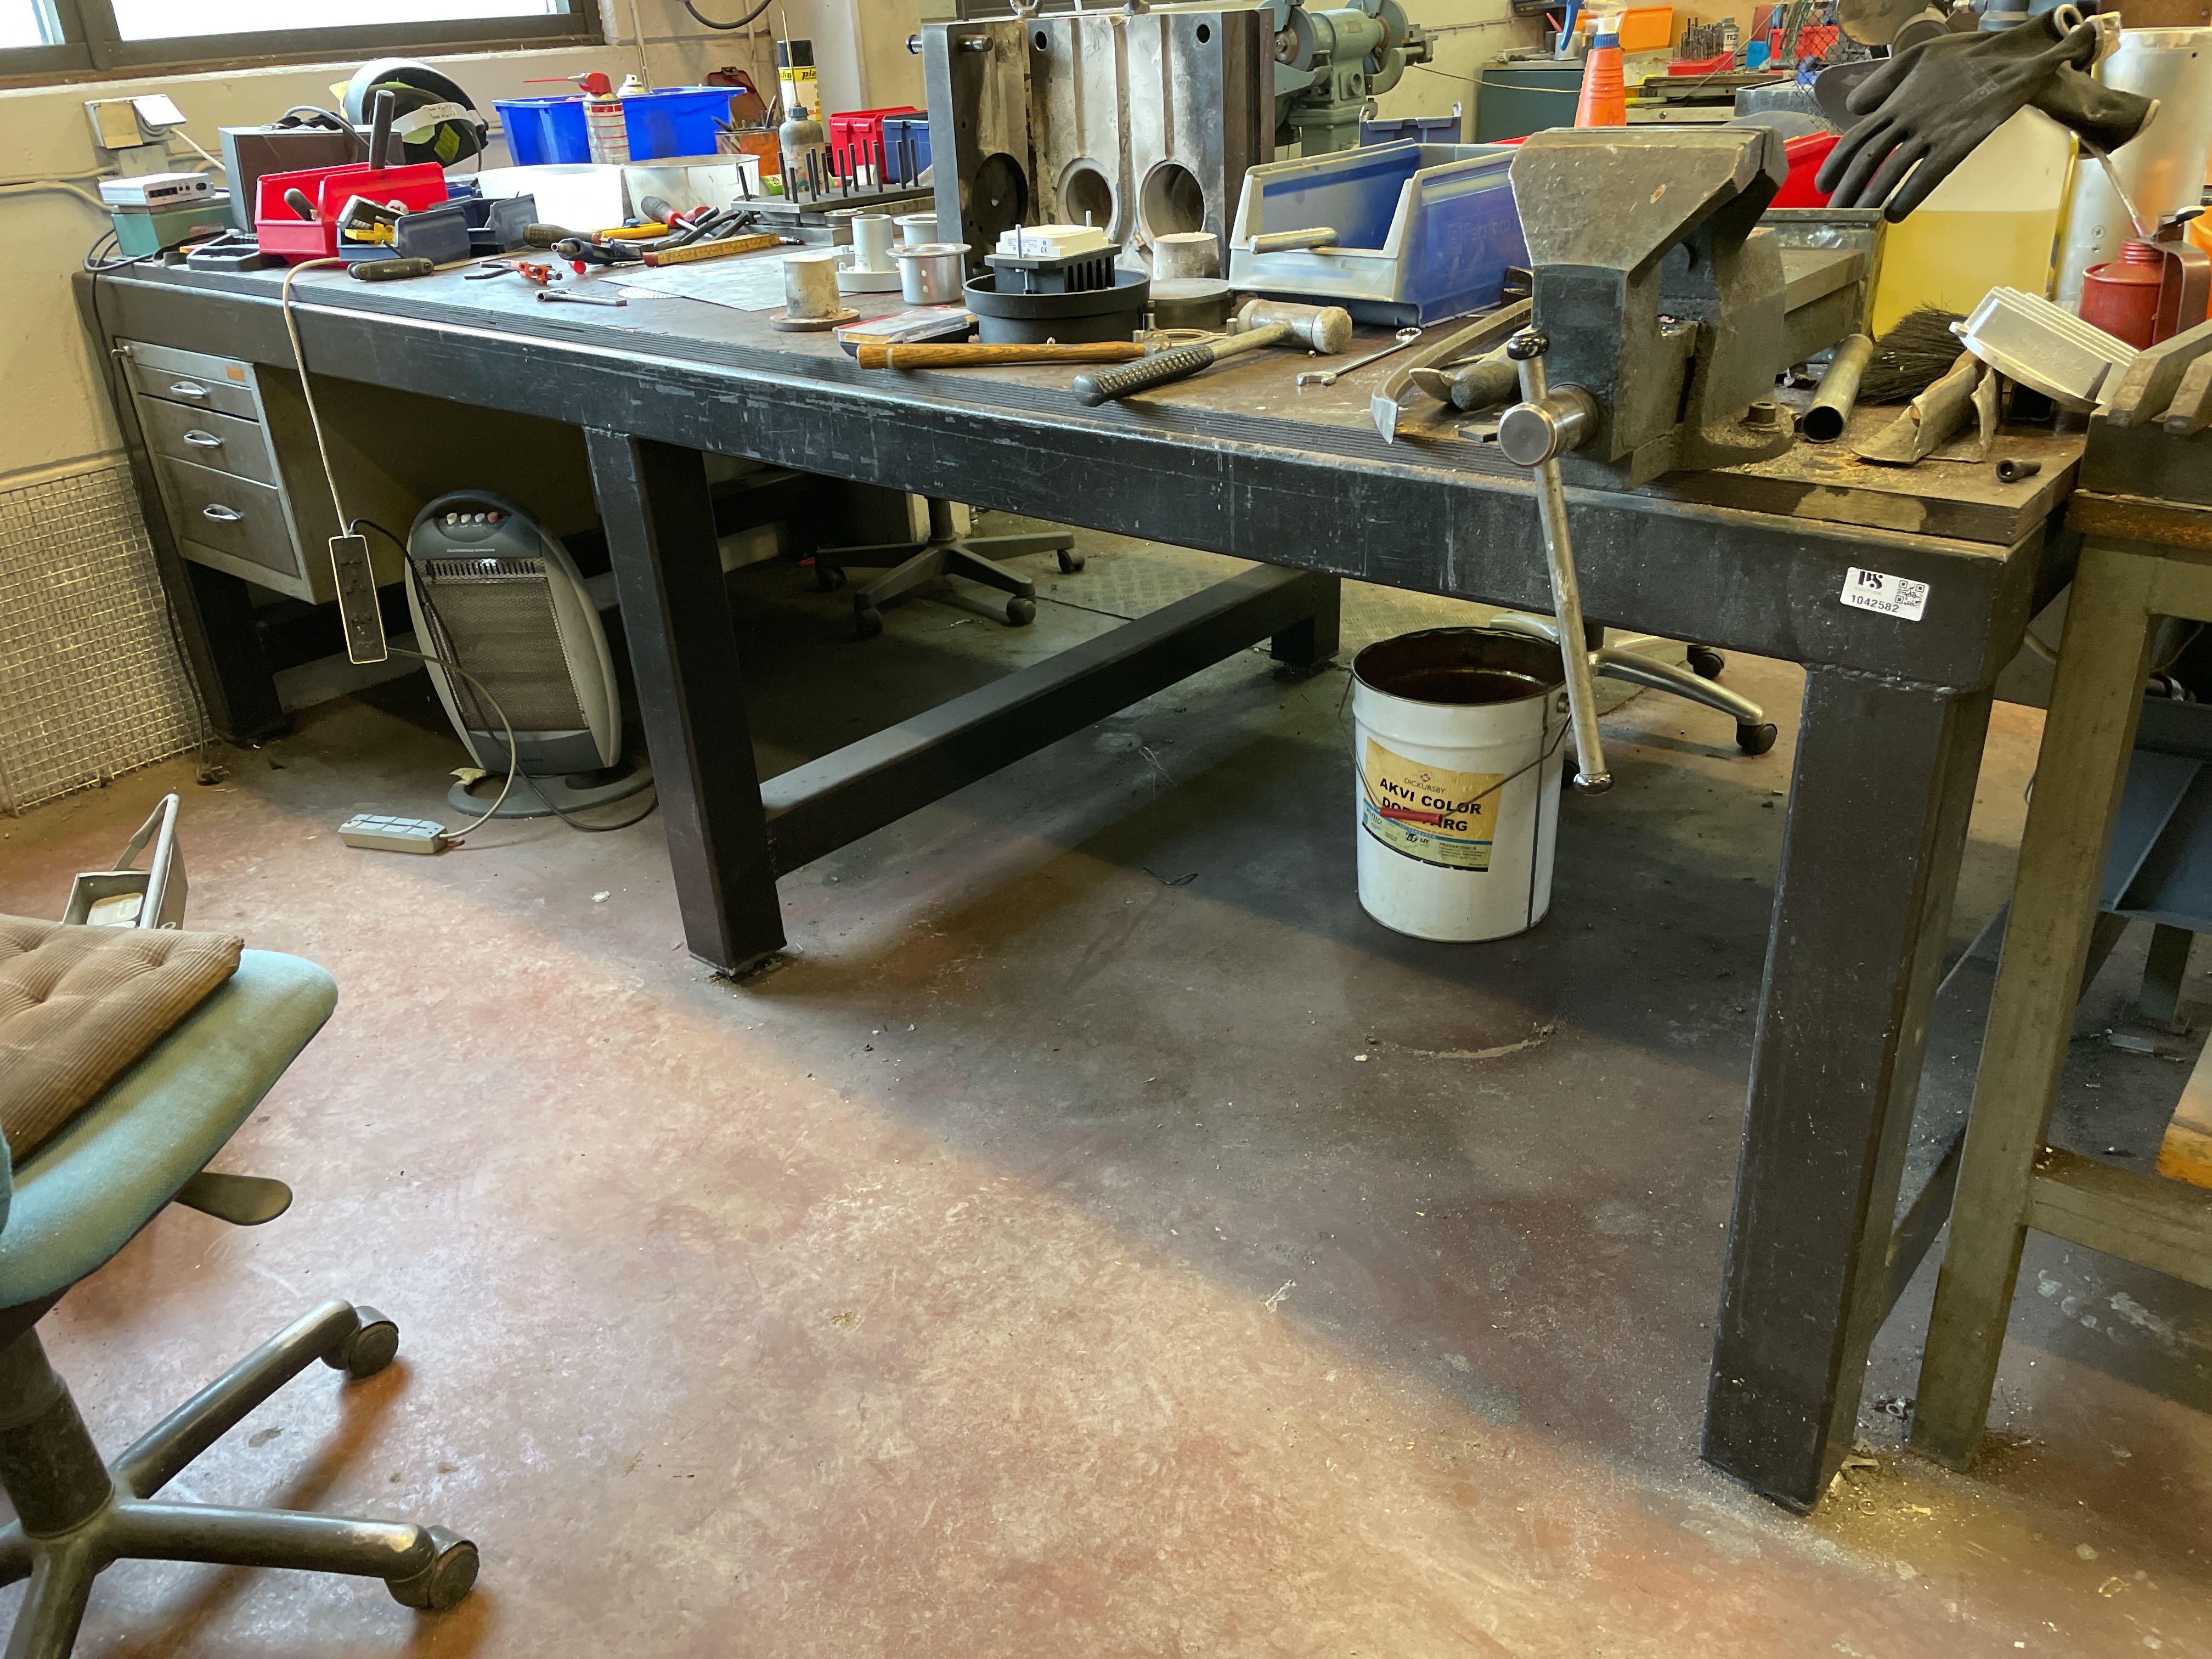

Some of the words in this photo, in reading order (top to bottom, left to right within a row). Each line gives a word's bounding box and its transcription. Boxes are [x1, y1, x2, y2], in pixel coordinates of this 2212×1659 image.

[1851, 595, 1899, 613] 1042582
[1404, 777, 1446, 794] DICKURSBY
[1380, 778, 1414, 802] AKVI
[1421, 795, 1482, 815] COLOR
